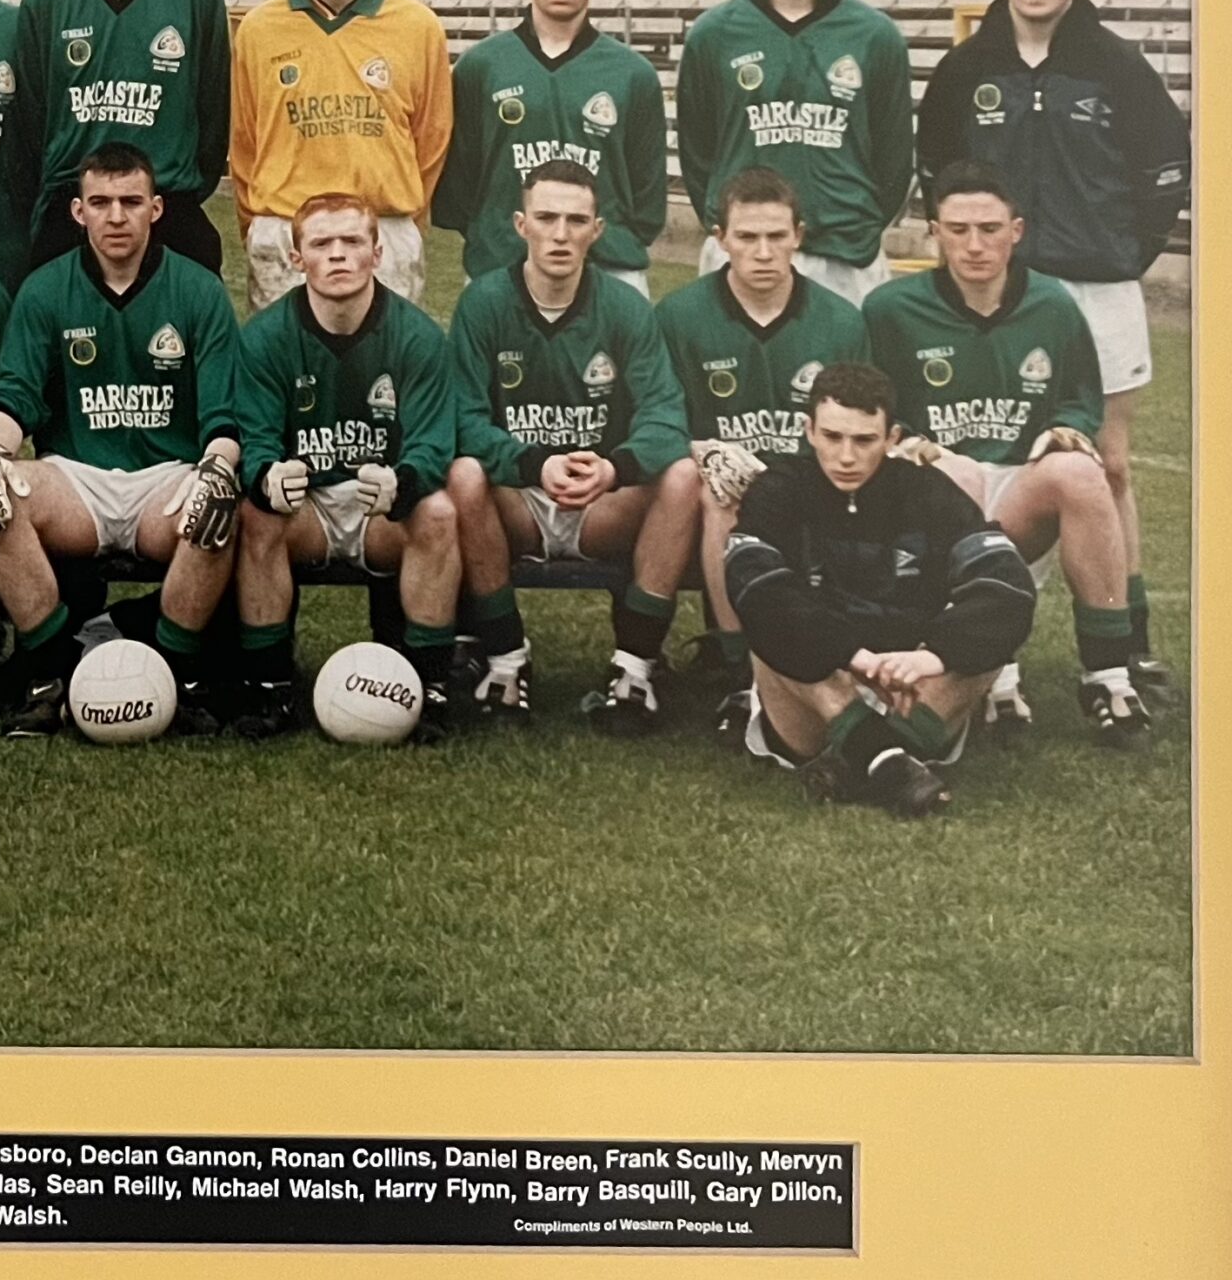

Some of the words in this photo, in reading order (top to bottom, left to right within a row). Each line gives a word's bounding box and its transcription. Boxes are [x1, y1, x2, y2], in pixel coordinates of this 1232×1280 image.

[80, 1144, 158, 1165] Declan
[166, 1145, 262, 1171] Gannon,
[271, 1147, 345, 1169] Ronan
[352, 1147, 437, 1170] Collins,
[445, 1146, 517, 1169] Daniel
[525, 1149, 598, 1173] Breen,
[605, 1148, 670, 1169] Frank
[676, 1148, 753, 1177] Scully,
[760, 1150, 843, 1175] Mervyn
[46, 1173, 104, 1195] Sean
[114, 1175, 182, 1201] Reilly,
[192, 1176, 280, 1198] Michael
[289, 1178, 365, 1203] Walsh,
[375, 1178, 438, 1203] Harry
[446, 1177, 517, 1204] Flynn,
[527, 1181, 590, 1207] Barry
[598, 1179, 697, 1205] Basquill,
[706, 1181, 763, 1208] Gary
[771, 1180, 843, 1205] Dillon,
[513, 1218, 601, 1236] Compliments
[604, 1218, 617, 1231] of
[619, 1219, 674, 1232] Western
[677, 1219, 724, 1235] People
[727, 1221, 753, 1234] Ltd.
